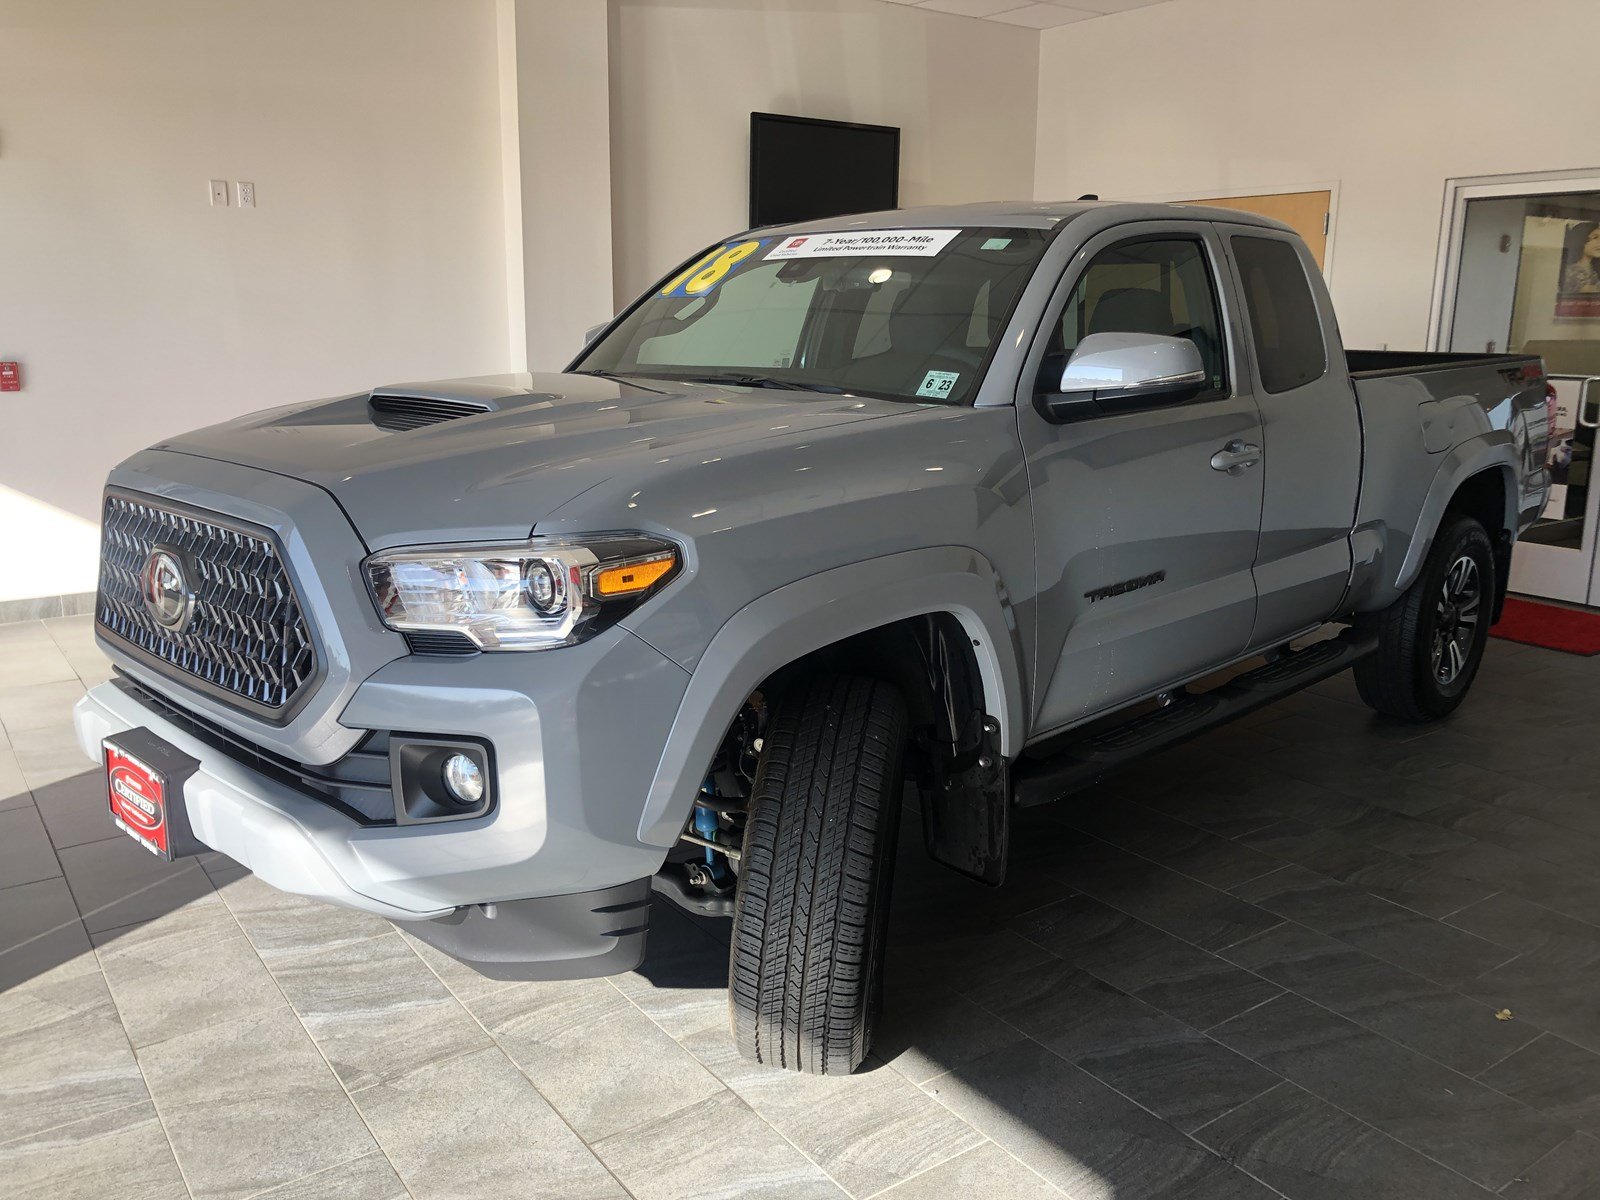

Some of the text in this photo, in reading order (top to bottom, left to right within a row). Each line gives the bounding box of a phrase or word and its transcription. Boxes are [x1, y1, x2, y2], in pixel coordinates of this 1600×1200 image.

[823, 235, 934, 245] 7-Year/100,000-Mile
[925, 378, 953, 391] 6 23
